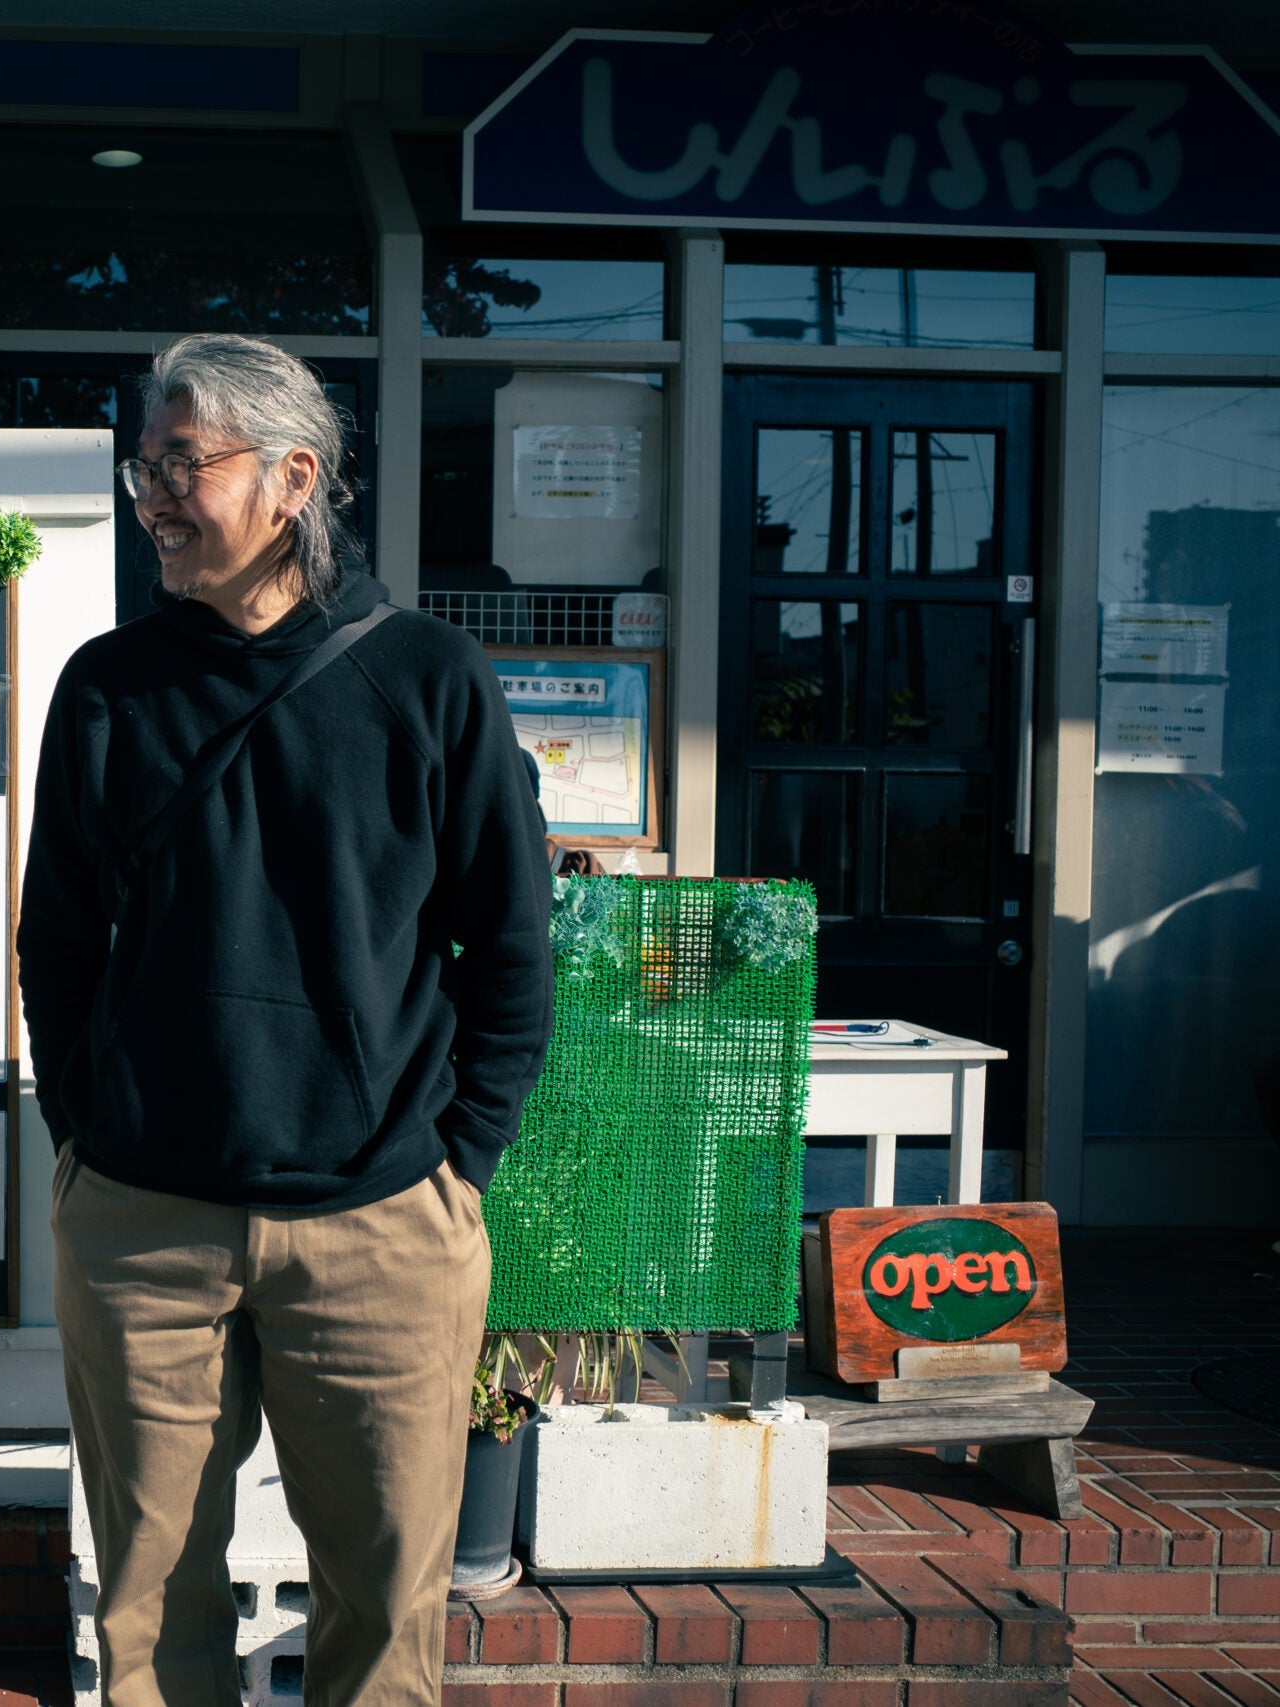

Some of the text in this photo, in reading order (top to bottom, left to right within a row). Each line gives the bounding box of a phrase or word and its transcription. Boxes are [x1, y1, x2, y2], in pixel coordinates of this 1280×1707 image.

[502, 680, 599, 695] 駐車場のご案内
[870, 1250, 1032, 1310] open
